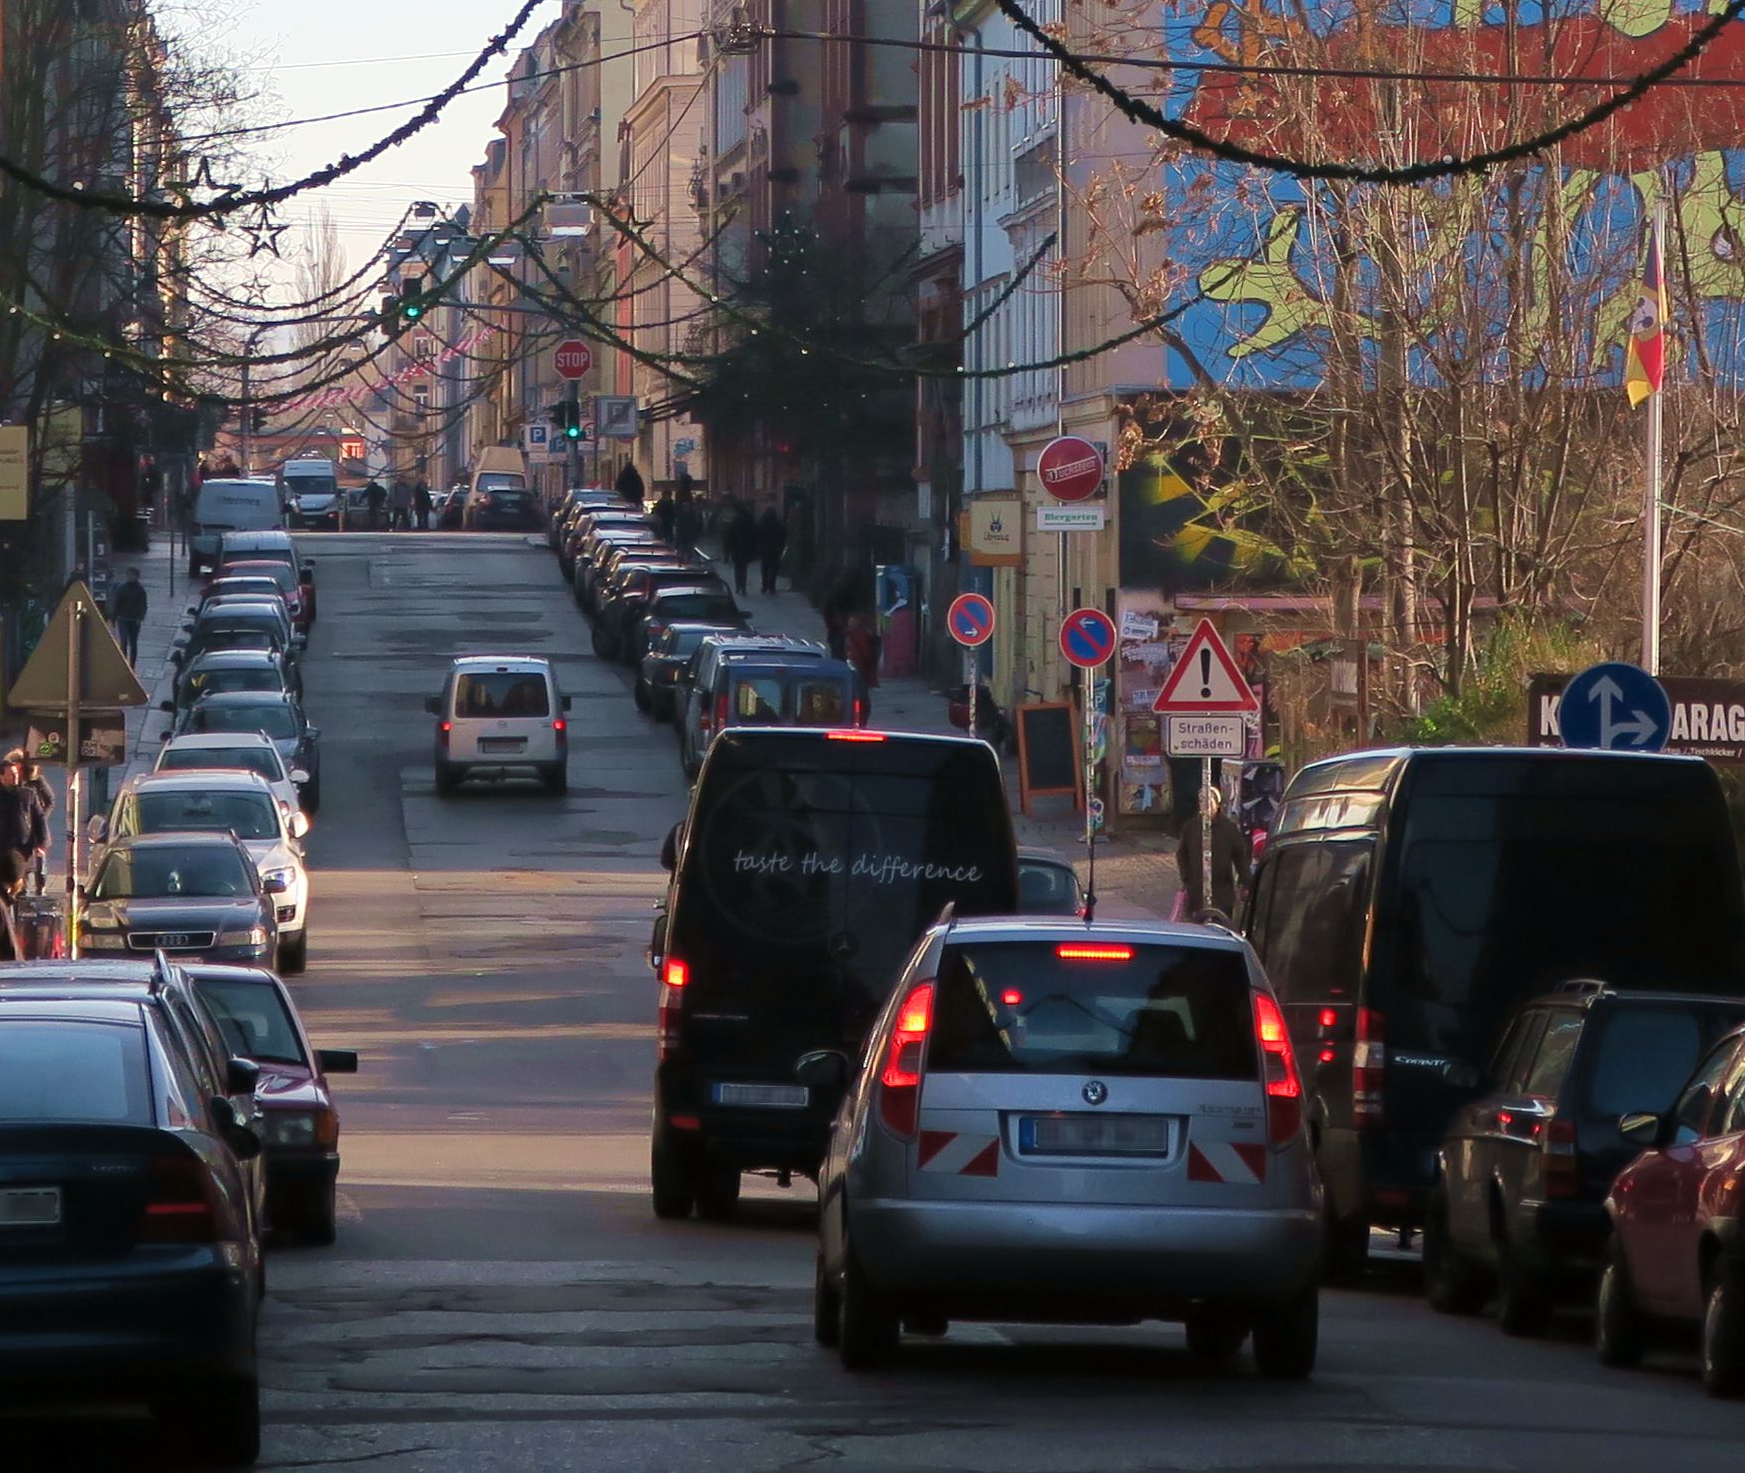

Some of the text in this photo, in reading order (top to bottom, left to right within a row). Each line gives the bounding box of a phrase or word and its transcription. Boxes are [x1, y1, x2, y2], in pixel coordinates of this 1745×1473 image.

[557, 352, 588, 368] STOP
[1044, 513, 1098, 523] Biergarten
[1178, 722, 1234, 734] Straßen-
[1180, 737, 1232, 749] schäden
[1690, 748, 1735, 758] Tischkicker
[733, 850, 984, 884] taste the difference
